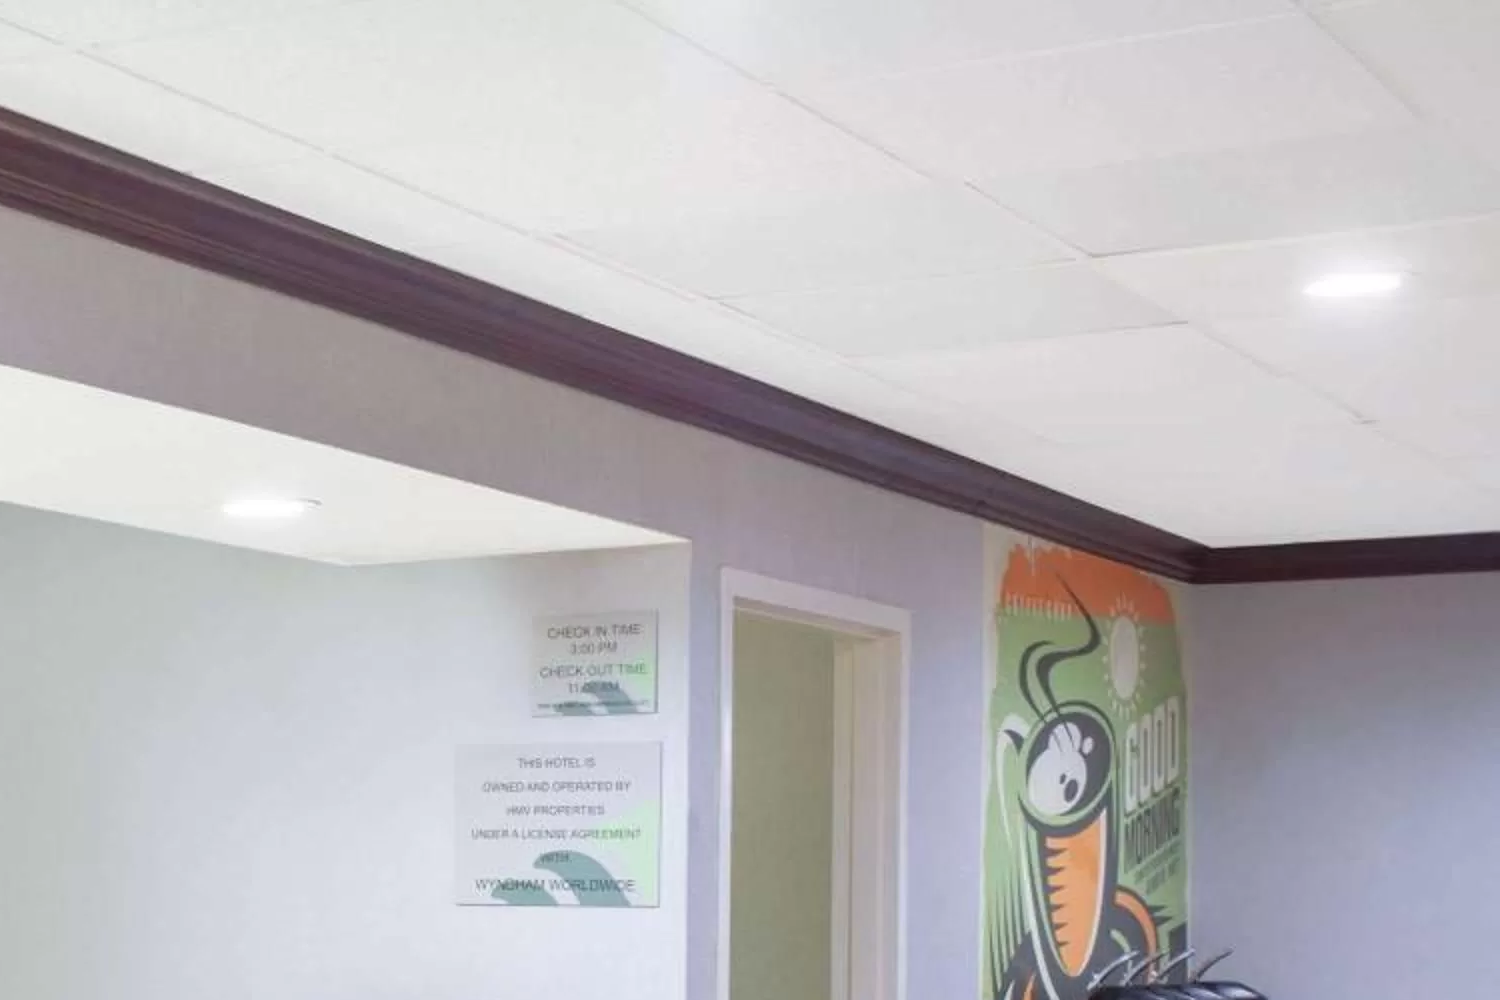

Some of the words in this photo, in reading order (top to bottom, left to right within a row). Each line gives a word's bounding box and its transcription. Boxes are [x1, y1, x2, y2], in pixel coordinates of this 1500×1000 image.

[1125, 696, 1179, 814] GOOD
[516, 757, 543, 769] THIS
[545, 757, 581, 769] HOTEL
[481, 781, 525, 793] OWNED
[527, 781, 550, 793] AND
[552, 781, 613, 793] OPERATED
[615, 781, 632, 793] BY
[533, 805, 606, 817] PROPERTIES
[470, 828, 509, 841] UNDER
[521, 828, 568, 841] LICENSE
[570, 828, 642, 841] AGREEMENT
[1124, 787, 1180, 873] MORNING
[475, 878, 546, 893] WYNDHAM
[549, 878, 636, 894] WORLDWIDE
